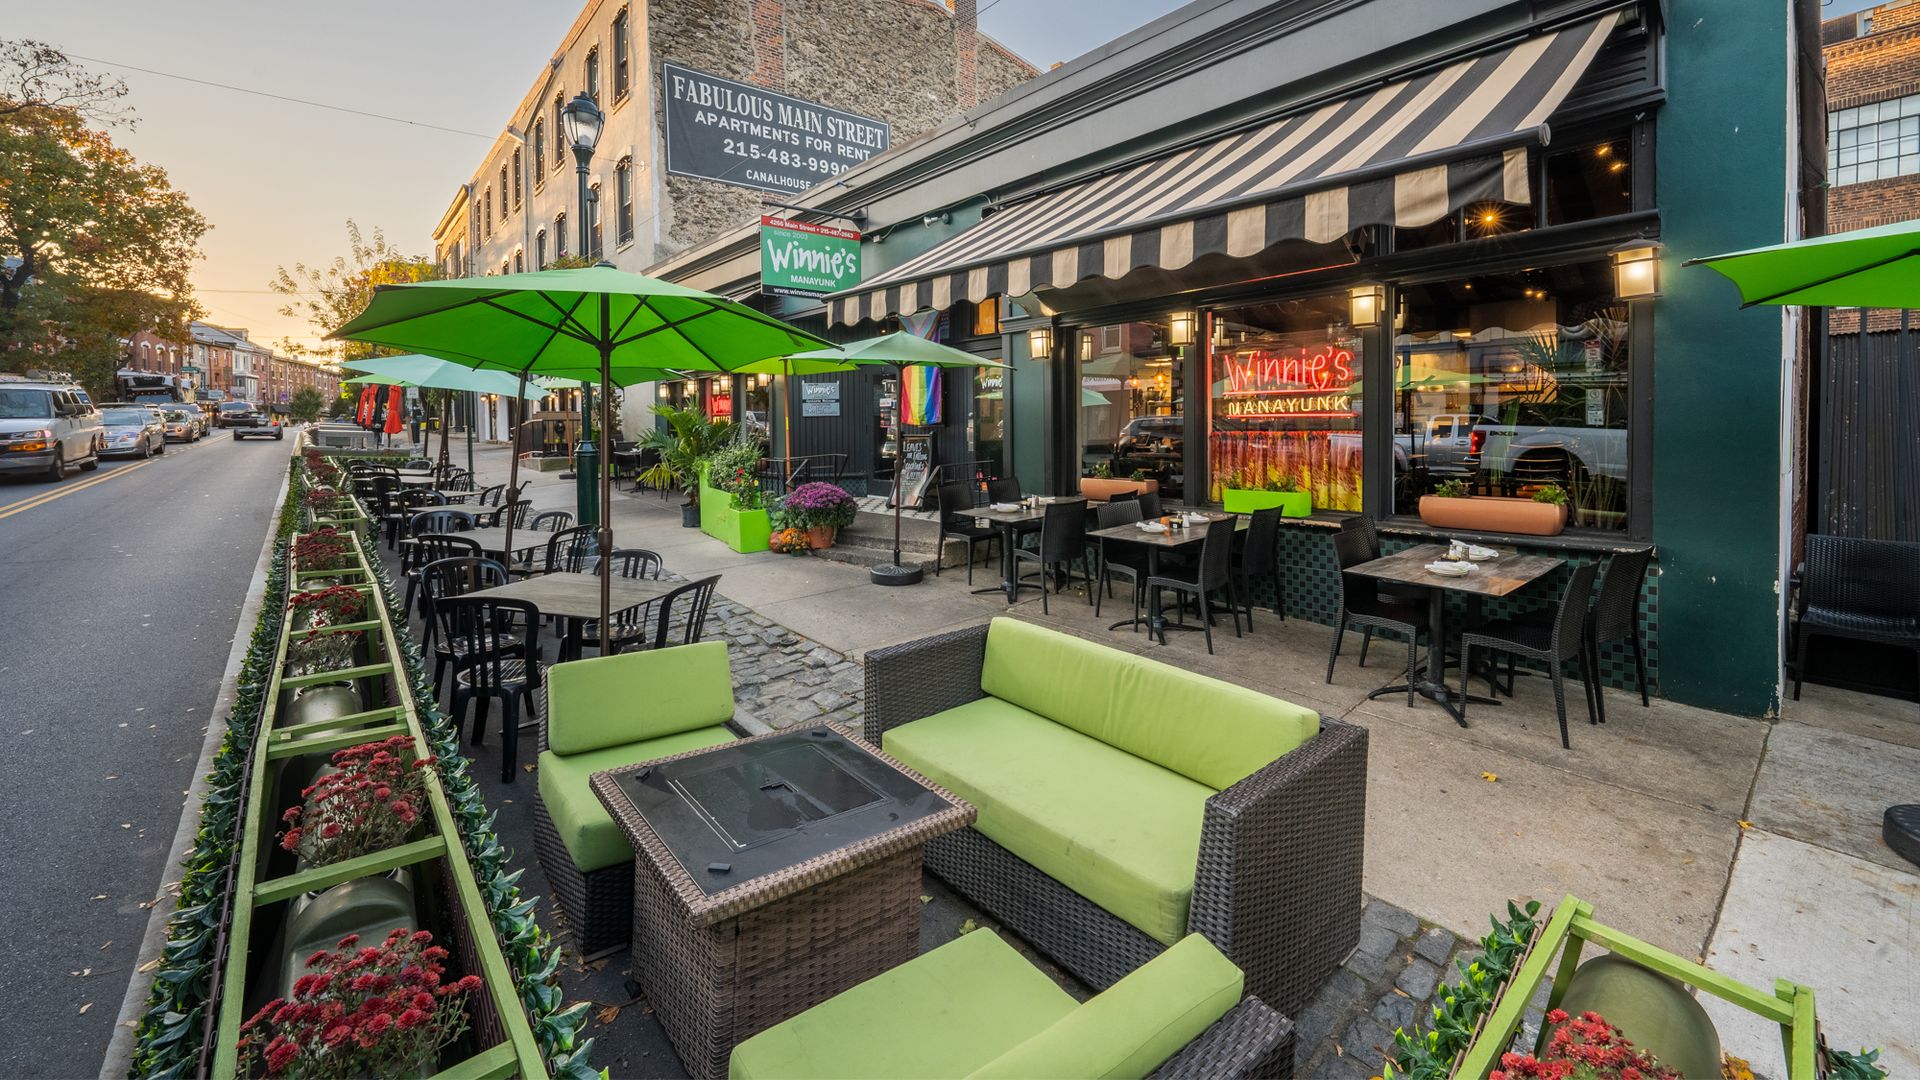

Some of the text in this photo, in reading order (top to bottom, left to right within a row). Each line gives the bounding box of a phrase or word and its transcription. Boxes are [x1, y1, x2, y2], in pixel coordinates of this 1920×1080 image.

[672, 75, 884, 149] FABULOUS MAIN STREET
[694, 110, 871, 161] APARTMENTS FOR RENT
[723, 138, 849, 176] 215-483-9990
[746, 169, 812, 190] CANALHOUSE
[785, 221, 798, 229] Main
[799, 224, 816, 232] Street
[767, 238, 857, 279] Winnie's
[790, 274, 836, 288] MANAYUNK
[1224, 346, 1350, 392] Winnie's
[1228, 395, 1348, 416] MANAYUNK
